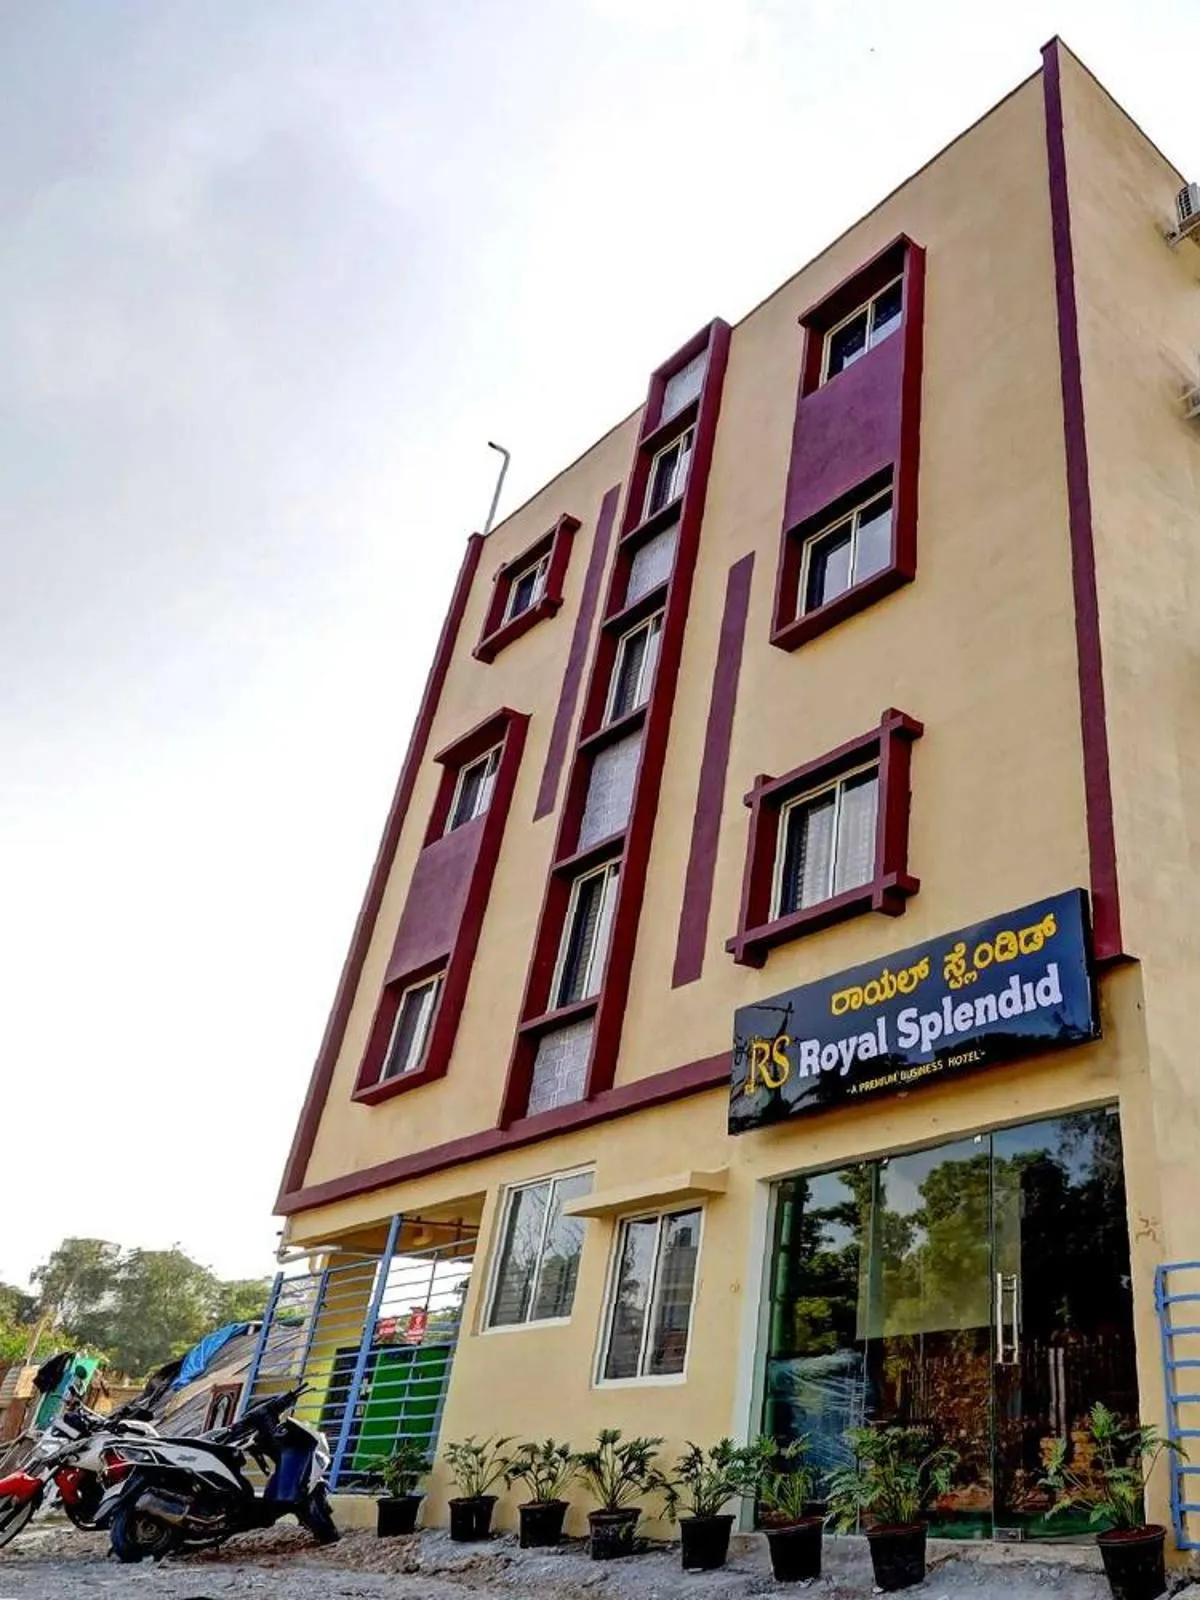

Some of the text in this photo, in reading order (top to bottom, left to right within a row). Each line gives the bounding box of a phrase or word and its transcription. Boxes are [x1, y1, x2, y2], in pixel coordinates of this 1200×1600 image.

[799, 962, 1062, 1076] Royal Splendid
[744, 1035, 790, 1094] RS
[859, 1072, 898, 1092] PREMIUM
[900, 1060, 943, 1081] BUSINESS
